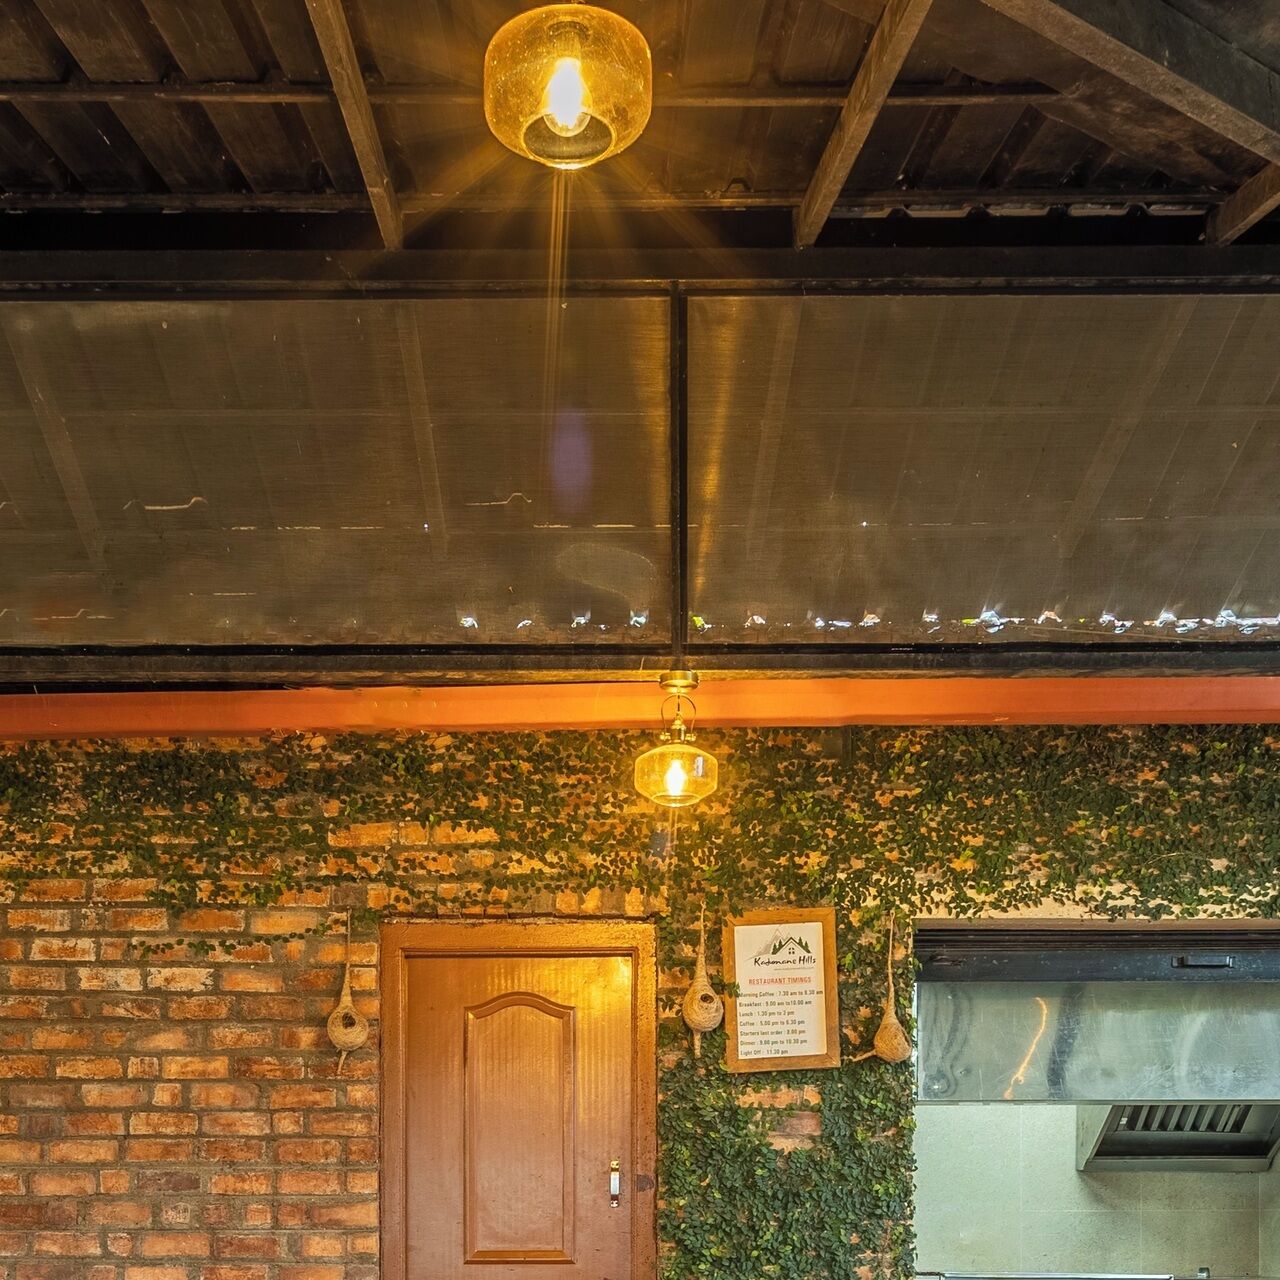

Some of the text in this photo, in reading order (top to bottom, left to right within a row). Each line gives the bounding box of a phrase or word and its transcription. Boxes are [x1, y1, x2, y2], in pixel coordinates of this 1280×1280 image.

[799, 955, 816, 965] Hills
[749, 976, 812, 985] RESTAURANT TIMINGS
